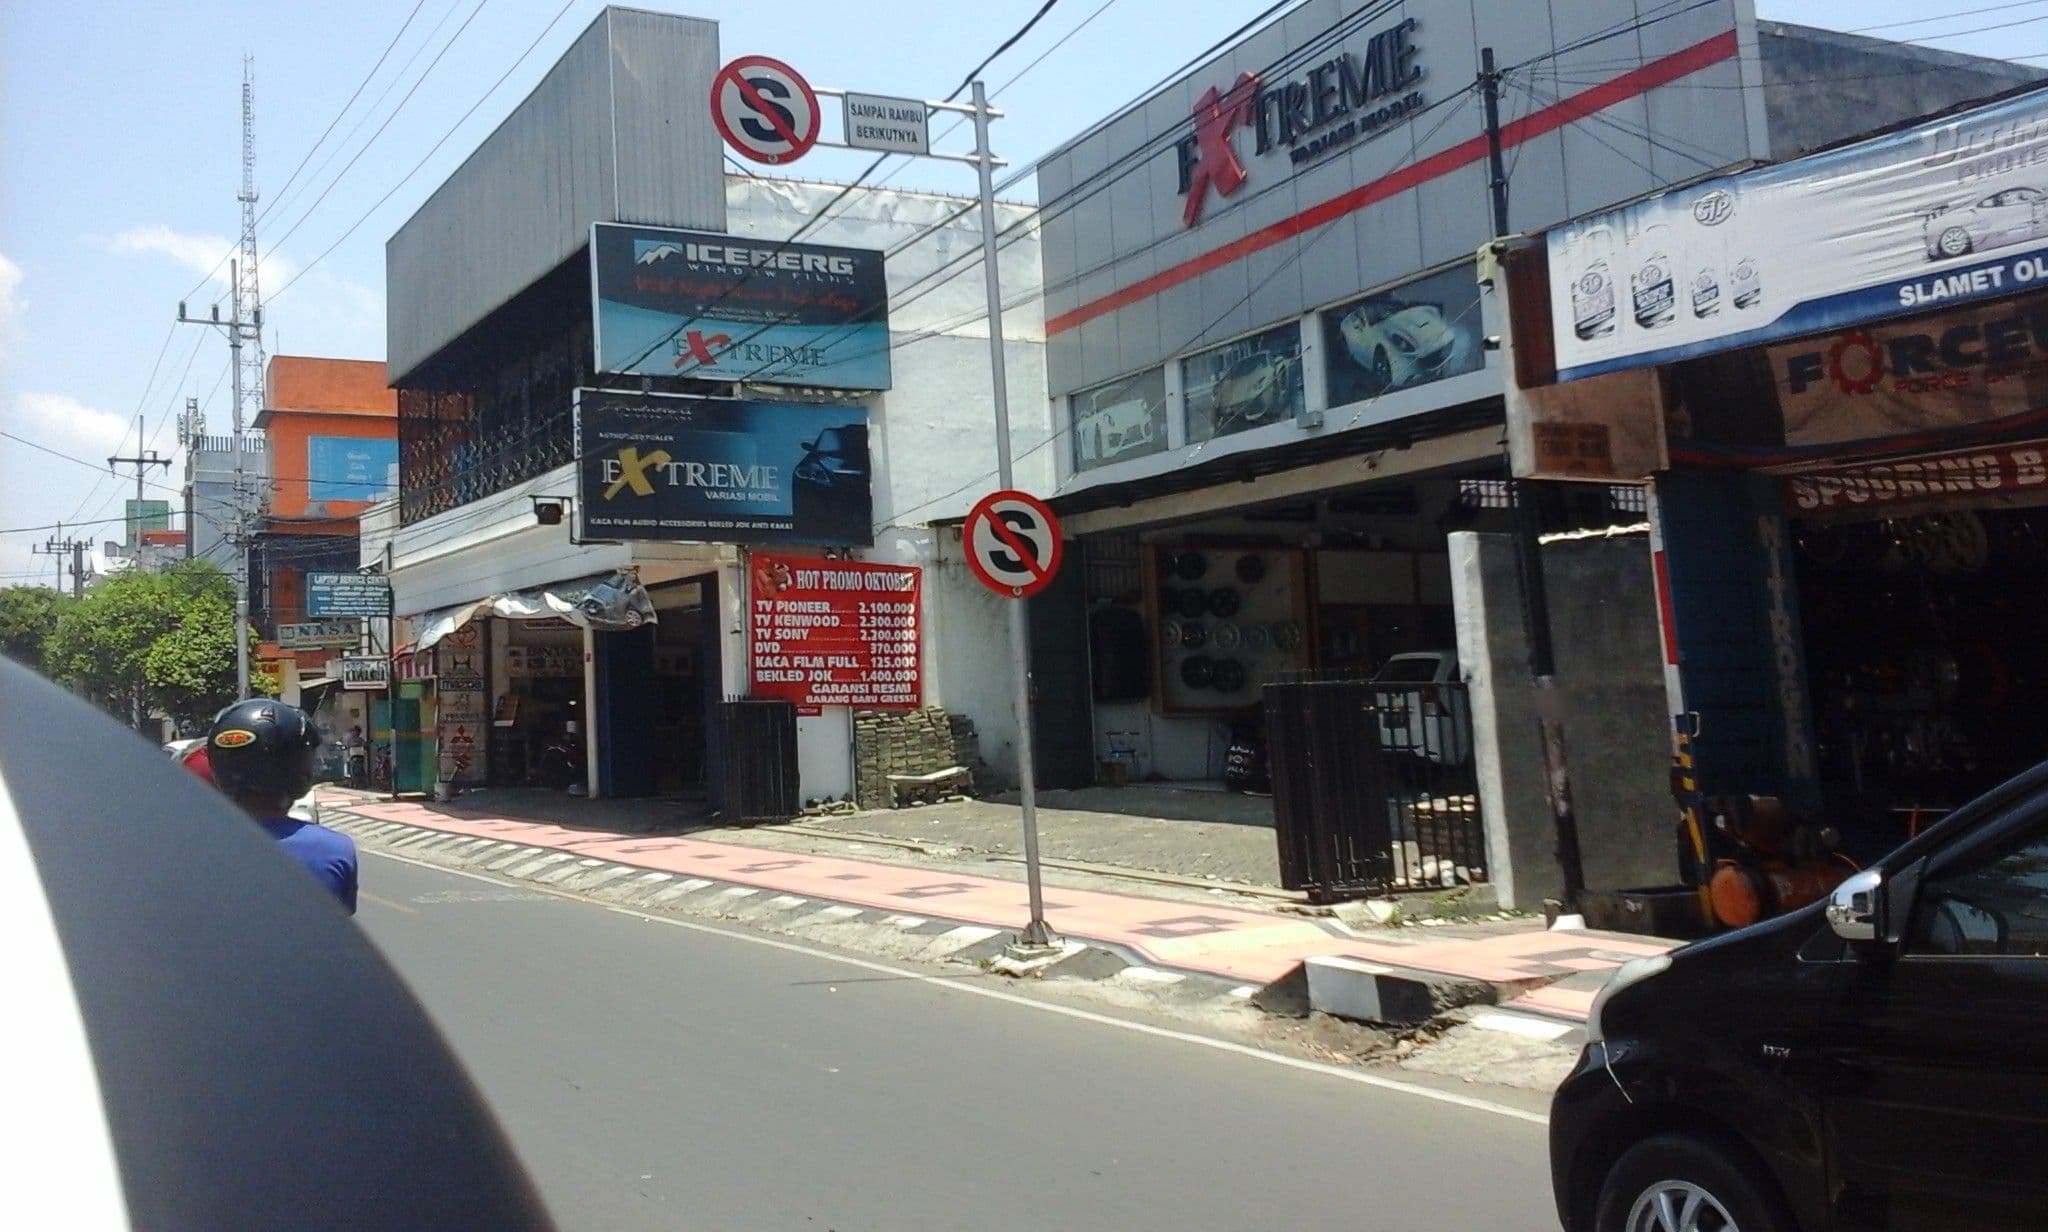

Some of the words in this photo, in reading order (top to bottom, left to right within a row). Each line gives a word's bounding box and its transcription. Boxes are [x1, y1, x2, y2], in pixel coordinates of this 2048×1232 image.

[851, 102, 887, 120] SAMPAI
[888, 107, 923, 123] RAMBU
[856, 125, 918, 144] BERIKUTNYA
[686, 242, 854, 276] ICEBERG
[1899, 265, 2006, 307] SLAMET
[2012, 256, 2048, 282] OL
[671, 329, 828, 369] EXTREME
[601, 446, 780, 501] EXTREME
[1792, 454, 2002, 510] SPOORING
[704, 490, 745, 502] VARIASI
[796, 570, 821, 591] HOT
[822, 571, 862, 591] PROMO
[756, 600, 773, 613] TV
[776, 601, 831, 614] PIONEER
[858, 601, 915, 615] 2.100.000
[755, 614, 772, 627] TV
[774, 615, 840, 628] KENWOOD
[859, 615, 916, 628] 2.300.000
[299, 623, 355, 637] NASA
[755, 628, 772, 640] TV
[774, 628, 809, 640] SONY
[860, 629, 917, 641] 2.200.000
[755, 641, 781, 654] DVD
[870, 642, 917, 655] 370.000
[755, 655, 790, 668] KACA
[792, 655, 826, 668] FILM
[827, 655, 860, 668] FULL
[870, 656, 917, 668] 125.000
[756, 669, 805, 682] BEKLED
[807, 670, 833, 682] JOK
[860, 670, 918, 682] 1.400.000
[811, 683, 869, 694] GARANSI
[872, 683, 911, 694] RESMI
[805, 694, 850, 704] BARANG
[851, 694, 878, 704] BARU
